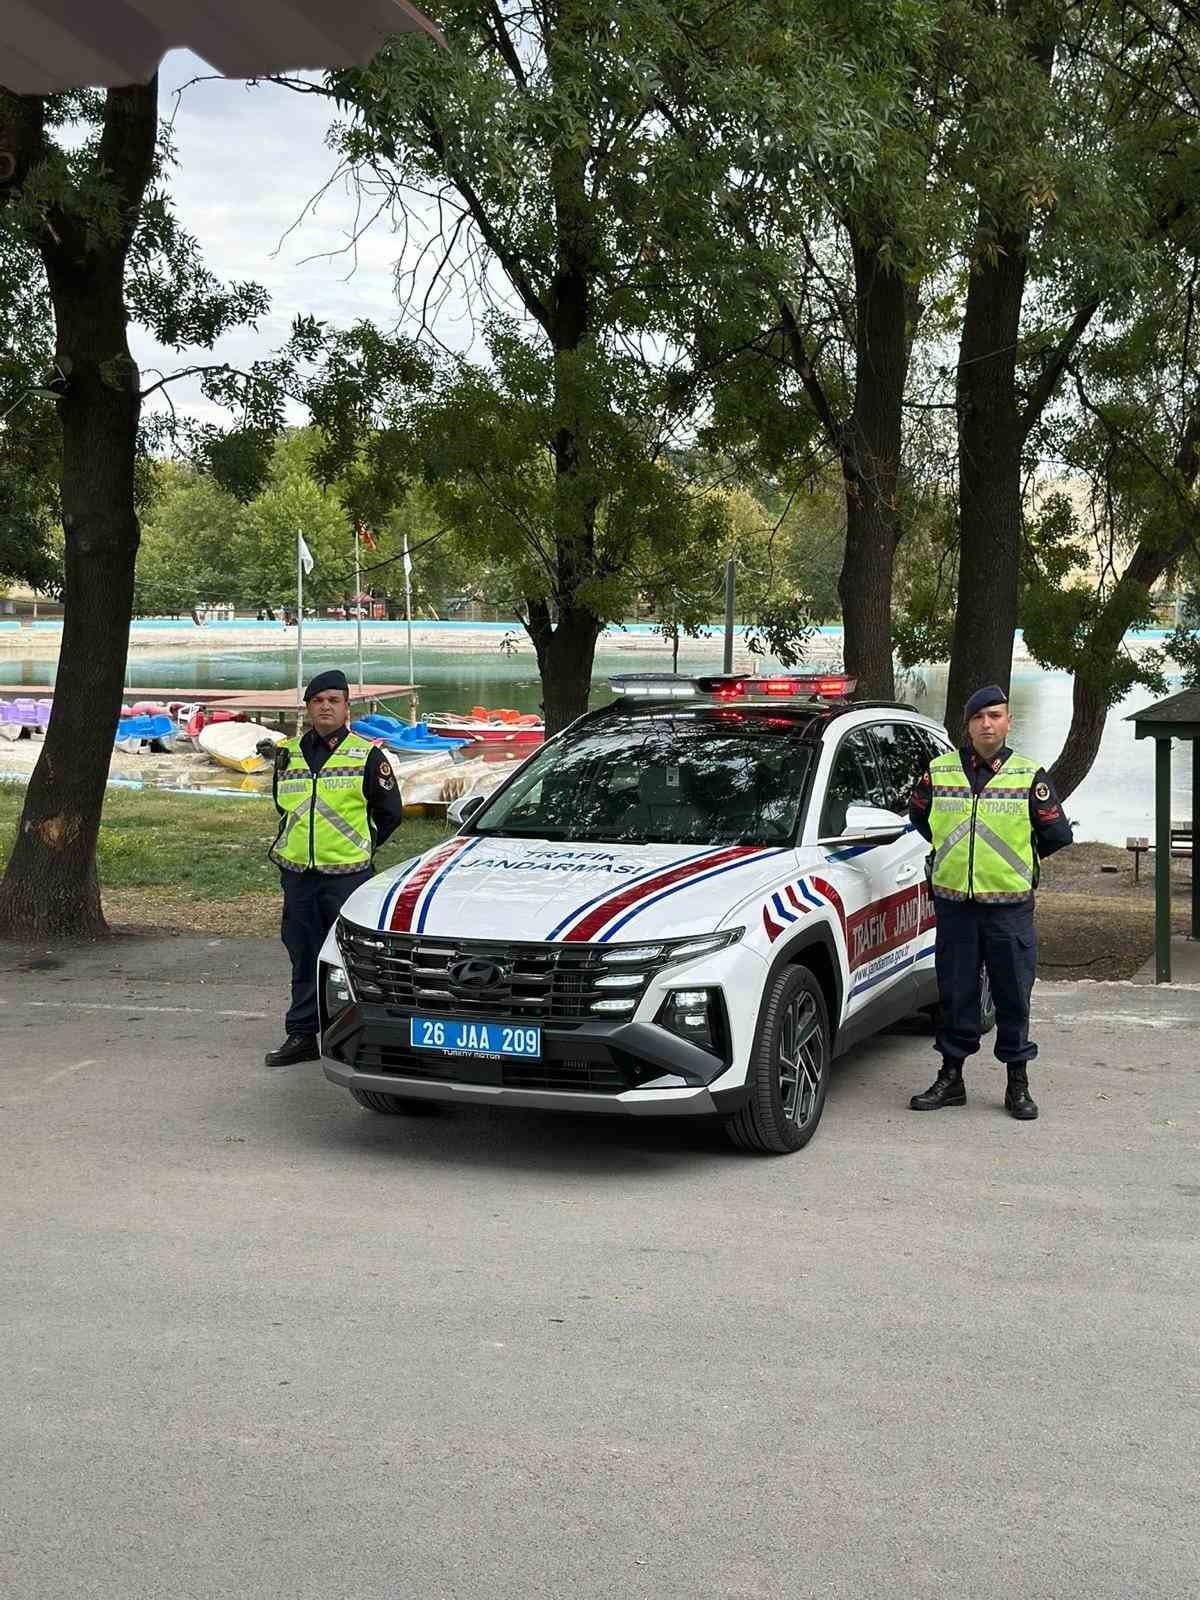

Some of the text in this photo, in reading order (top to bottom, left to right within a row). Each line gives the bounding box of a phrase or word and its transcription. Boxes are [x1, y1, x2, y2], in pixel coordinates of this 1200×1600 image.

[460, 859, 644, 875] JANDARMASI
[423, 1021, 537, 1053] 26 JAA 209
